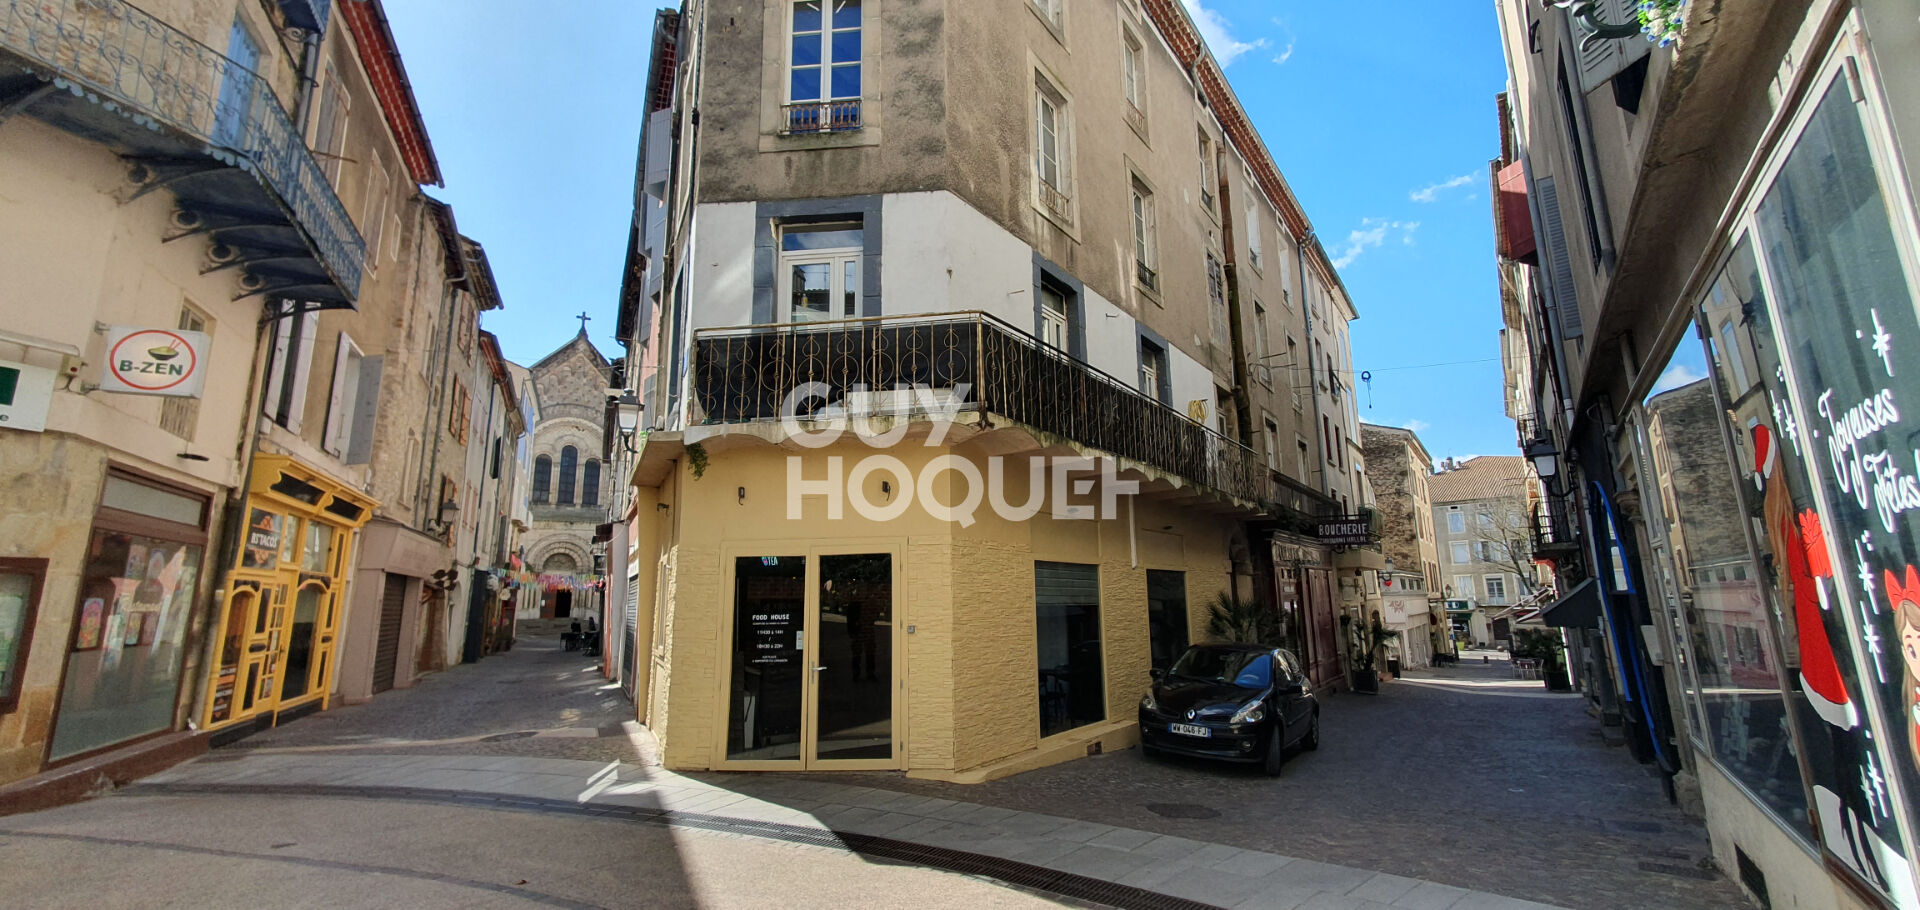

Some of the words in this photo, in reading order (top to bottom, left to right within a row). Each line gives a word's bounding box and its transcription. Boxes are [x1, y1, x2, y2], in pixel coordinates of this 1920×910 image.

[119, 360, 183, 375] B-ZEN
[1818, 387, 1900, 510] Joyeuses
[1318, 523, 1368, 536] BOUCHERIE
